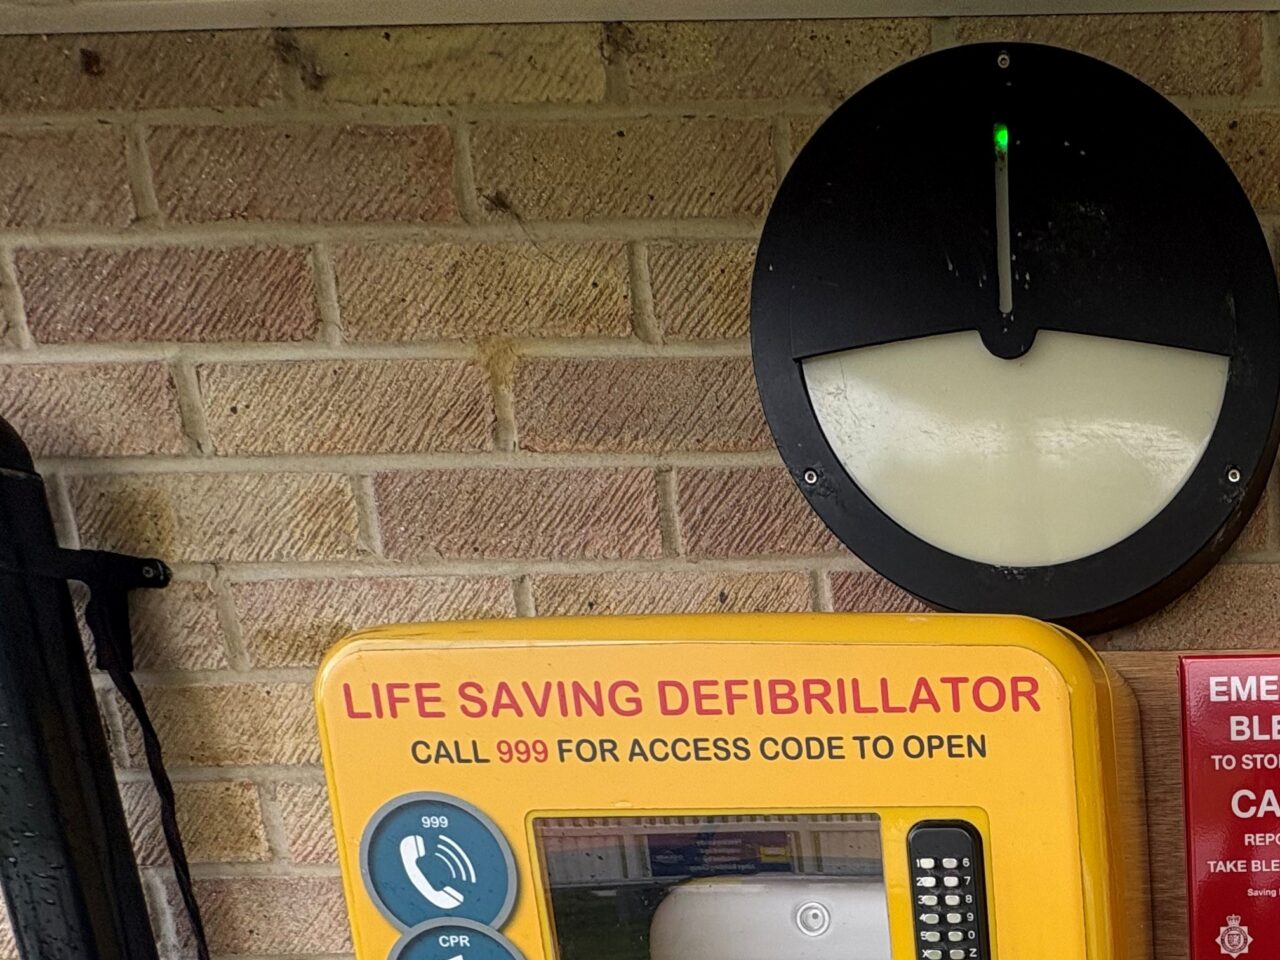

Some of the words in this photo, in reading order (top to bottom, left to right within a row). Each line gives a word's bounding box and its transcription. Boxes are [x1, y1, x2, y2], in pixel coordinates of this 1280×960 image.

[343, 683, 445, 719] LIFE
[458, 680, 642, 718] SAVING
[658, 676, 1040, 716] DEFIBRILLATOR
[412, 740, 490, 764] CALL
[497, 740, 548, 763] 999
[557, 739, 619, 762] FOR
[629, 737, 750, 762] ACCESS
[760, 737, 845, 760] CODE
[853, 736, 894, 759] TO
[903, 735, 986, 758] OPEN
[1211, 755, 1236, 770] TO
[422, 816, 448, 828] 999
[916, 859, 920, 867] 1
[963, 859, 970, 867] 6
[1207, 860, 1247, 872] TAKE
[916, 878, 924, 886] 2
[964, 877, 971, 885] 7
[1248, 889, 1276, 897] Saving
[918, 895, 925, 904] 3
[965, 895, 972, 903] 8
[967, 913, 973, 921] 9
[921, 932, 927, 940] 5
[968, 931, 975, 939] 0
[439, 936, 470, 947] CPR
[922, 949, 929, 958] X
[970, 949, 977, 957] Z
